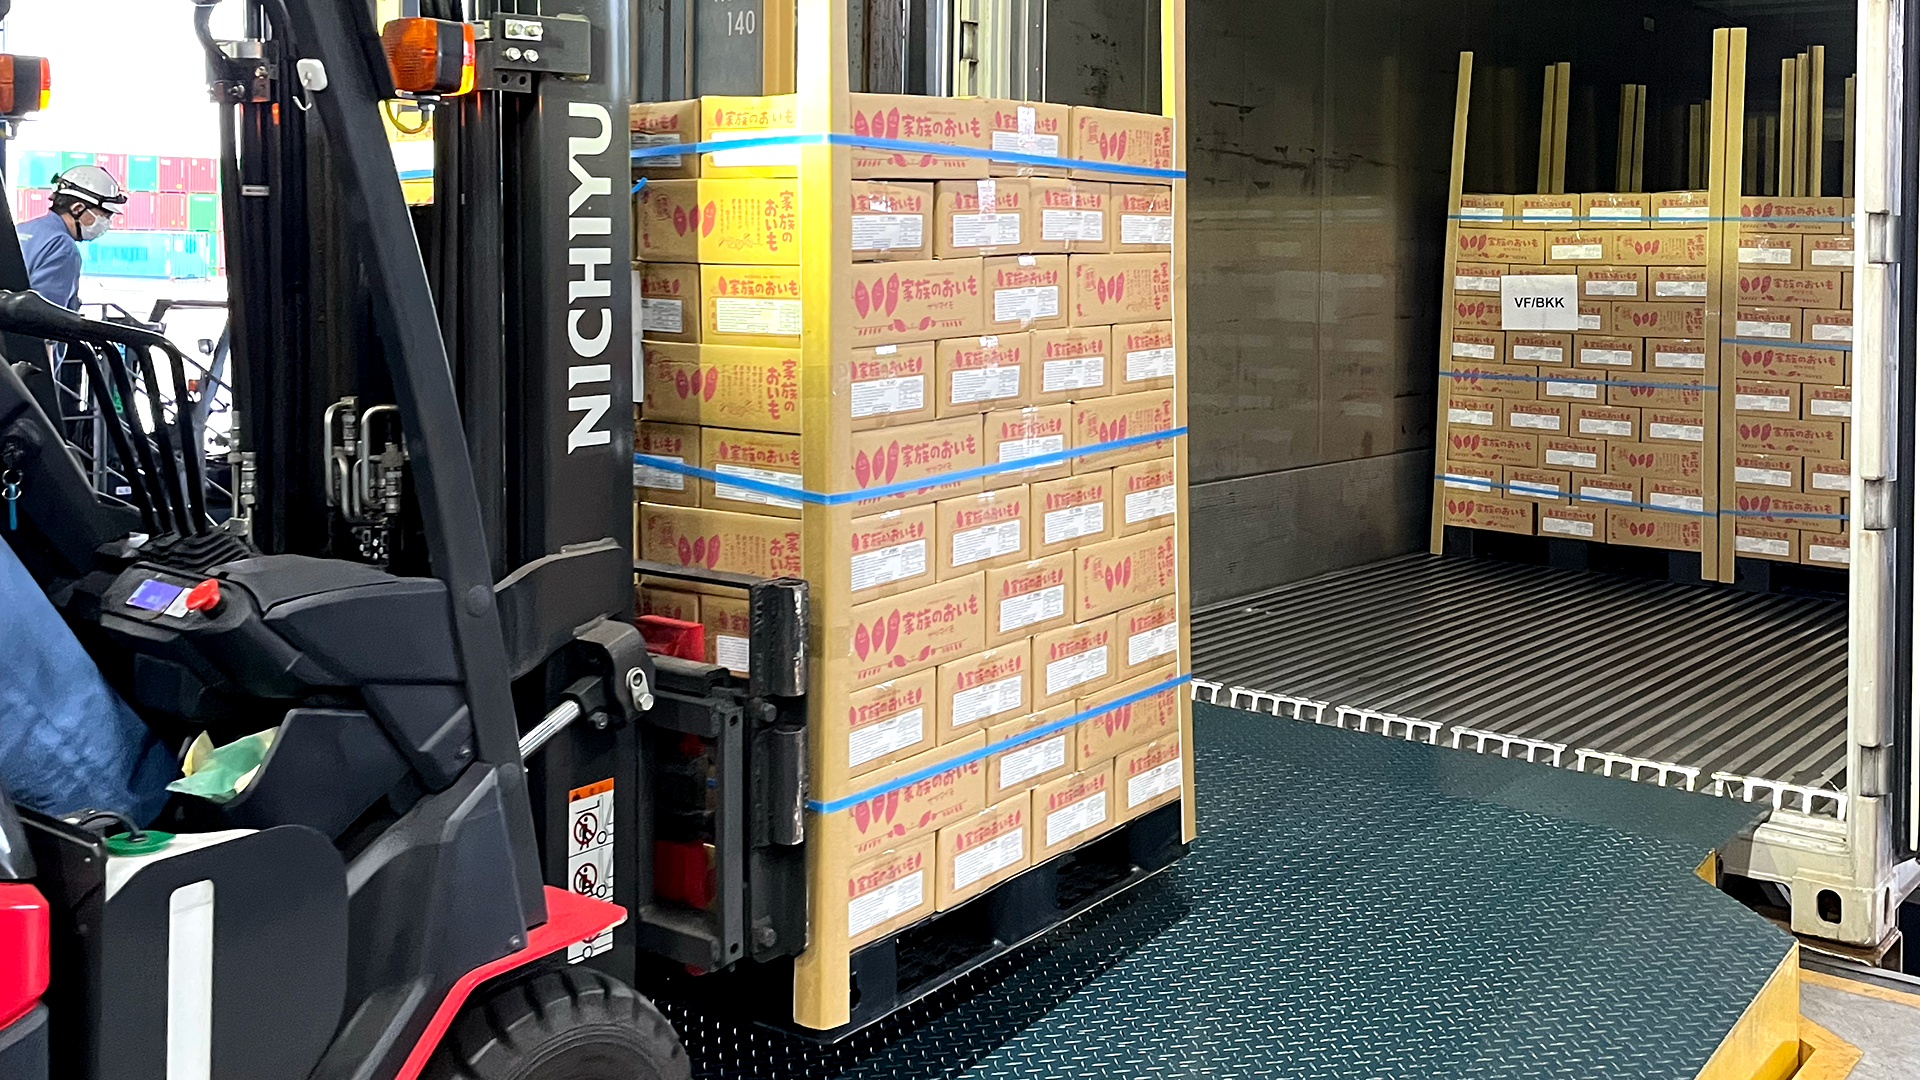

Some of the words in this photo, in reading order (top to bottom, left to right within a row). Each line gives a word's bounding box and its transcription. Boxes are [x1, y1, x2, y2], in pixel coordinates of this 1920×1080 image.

[728, 10, 755, 36] 140
[725, 111, 793, 126] 家族のおいも
[902, 114, 980, 138] 家族のおいも
[765, 199, 778, 251] おいも
[780, 190, 795, 242] 家族の
[568, 102, 612, 454] NICHIYU
[730, 279, 798, 295] 家族のおいも
[902, 275, 977, 302] 家族のおいも
[1514, 297, 1564, 308] VF/BKK
[767, 367, 781, 420] おいも
[782, 359, 797, 411] 家族の
[730, 445, 800, 465] 家族のおいも
[902, 435, 976, 467] 家族のおいも
[784, 532, 800, 577] 家族
[902, 594, 978, 635] 家族のおいも
